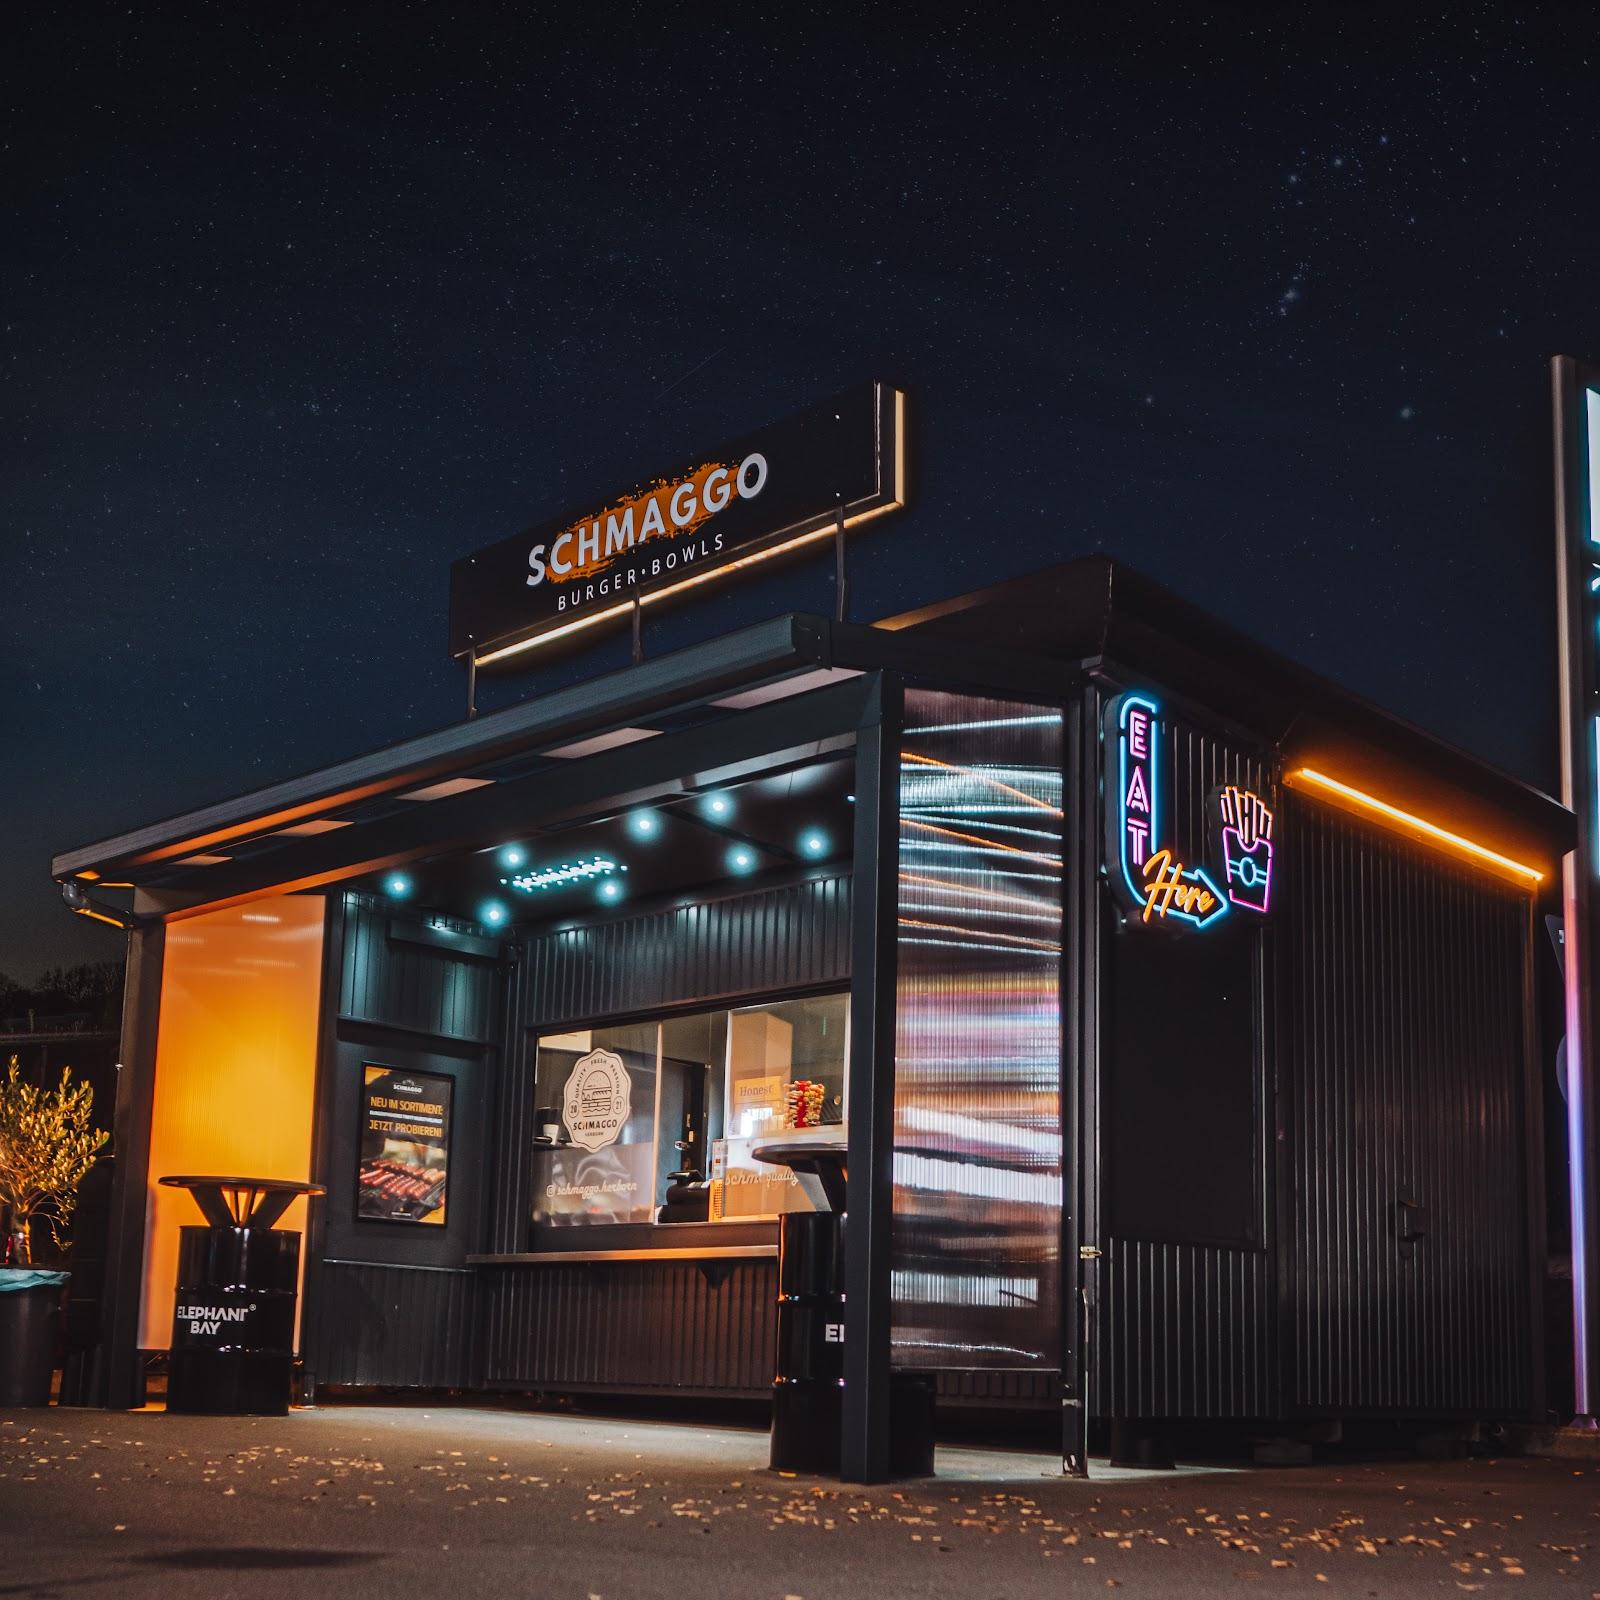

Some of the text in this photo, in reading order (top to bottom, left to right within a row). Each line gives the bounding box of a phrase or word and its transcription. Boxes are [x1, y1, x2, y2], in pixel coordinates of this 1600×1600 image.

[526, 453, 768, 586] SCHMAGGO
[1126, 710, 1149, 866] EAT
[1143, 850, 1215, 923] Here
[370, 1096, 387, 1108] NEU
[388, 1099, 398, 1110] IM
[369, 1119, 442, 1138] JETZT PROBIEREN!
[190, 1321, 222, 1335] BAY
